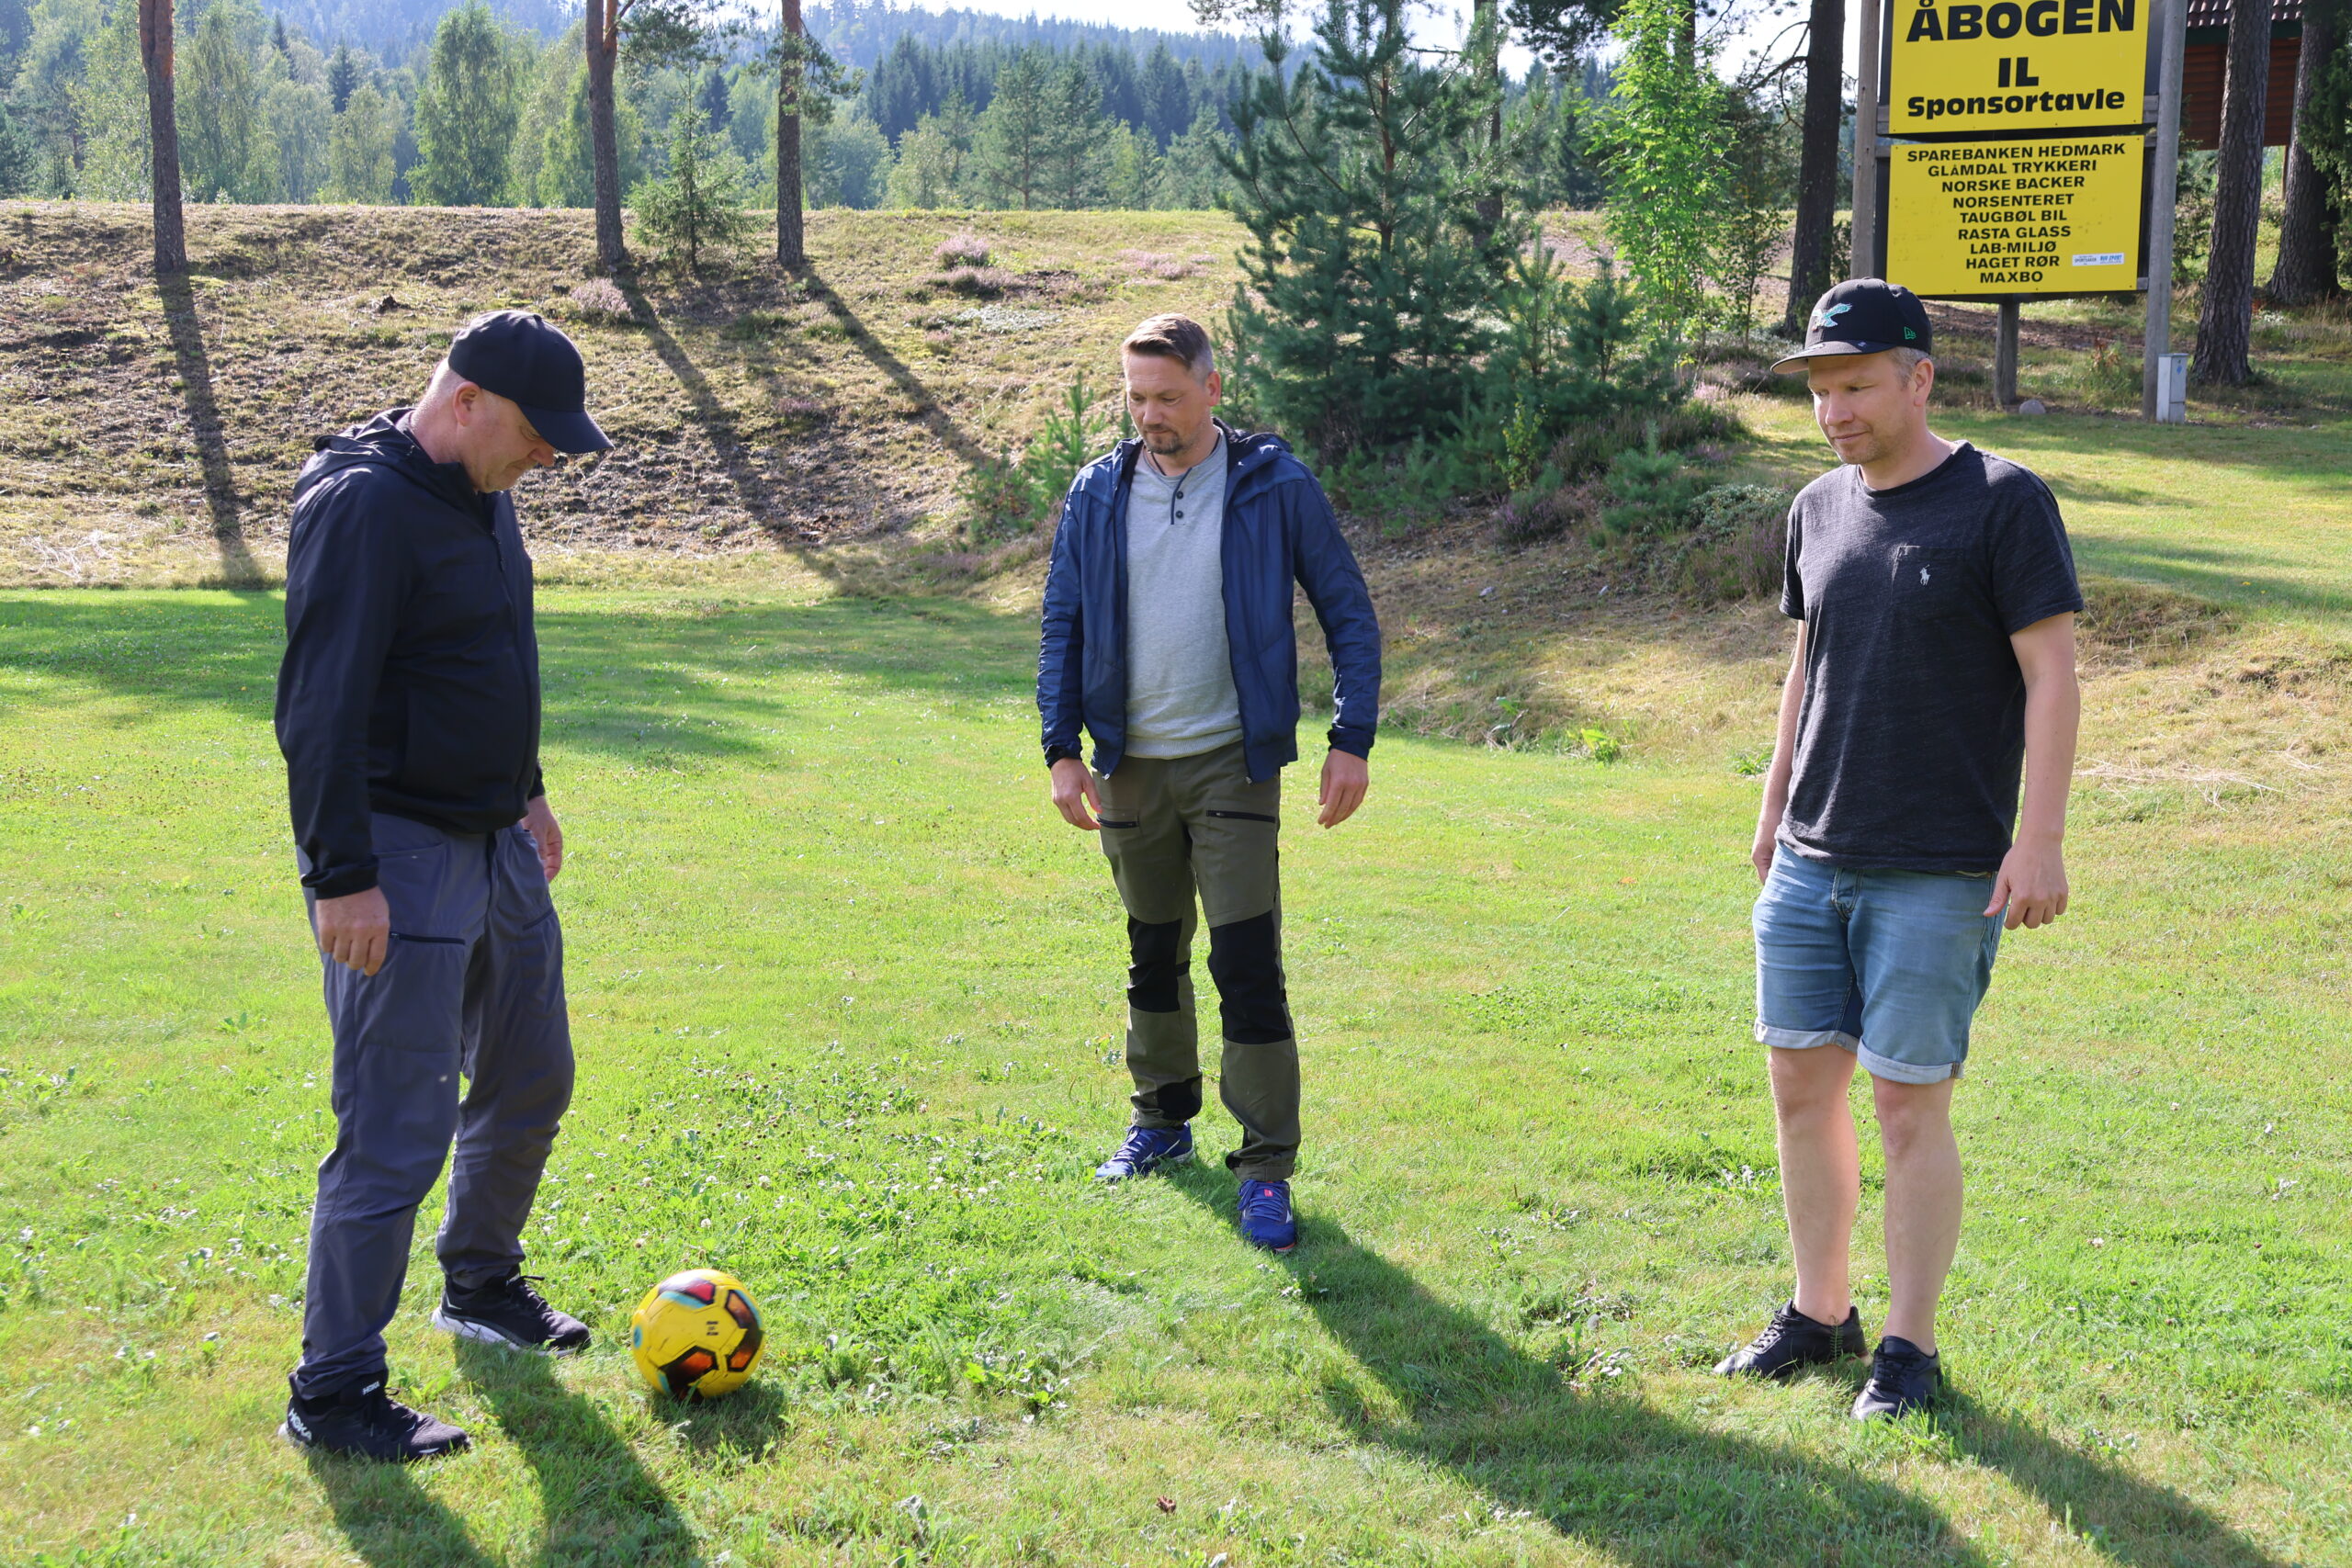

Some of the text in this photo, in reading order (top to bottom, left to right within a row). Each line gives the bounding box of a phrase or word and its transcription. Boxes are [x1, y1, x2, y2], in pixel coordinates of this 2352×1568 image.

[1906, 0, 2135, 42] ÅBOGEN
[1998, 57, 2039, 87] IL
[1908, 89, 2124, 119] Sponsortavle
[1907, 143, 2124, 162] SPAREBANKEN HEDMARK
[2012, 160, 2096, 174] TRYKKERI
[1942, 176, 2085, 192] NORSKE BACKER
[1953, 194, 2074, 209] NORSENTERET
[1960, 210, 2066, 223] TAUGBØL BIL
[1959, 226, 2071, 240] RASTA GLASS
[1971, 242, 2056, 254] LAB-MILJØ
[1966, 256, 2059, 269] HAGET RØR
[1981, 271, 2042, 283] MAXBO
[362, 1381, 380, 1395] HOKA
[288, 1408, 312, 1441] HOKA
